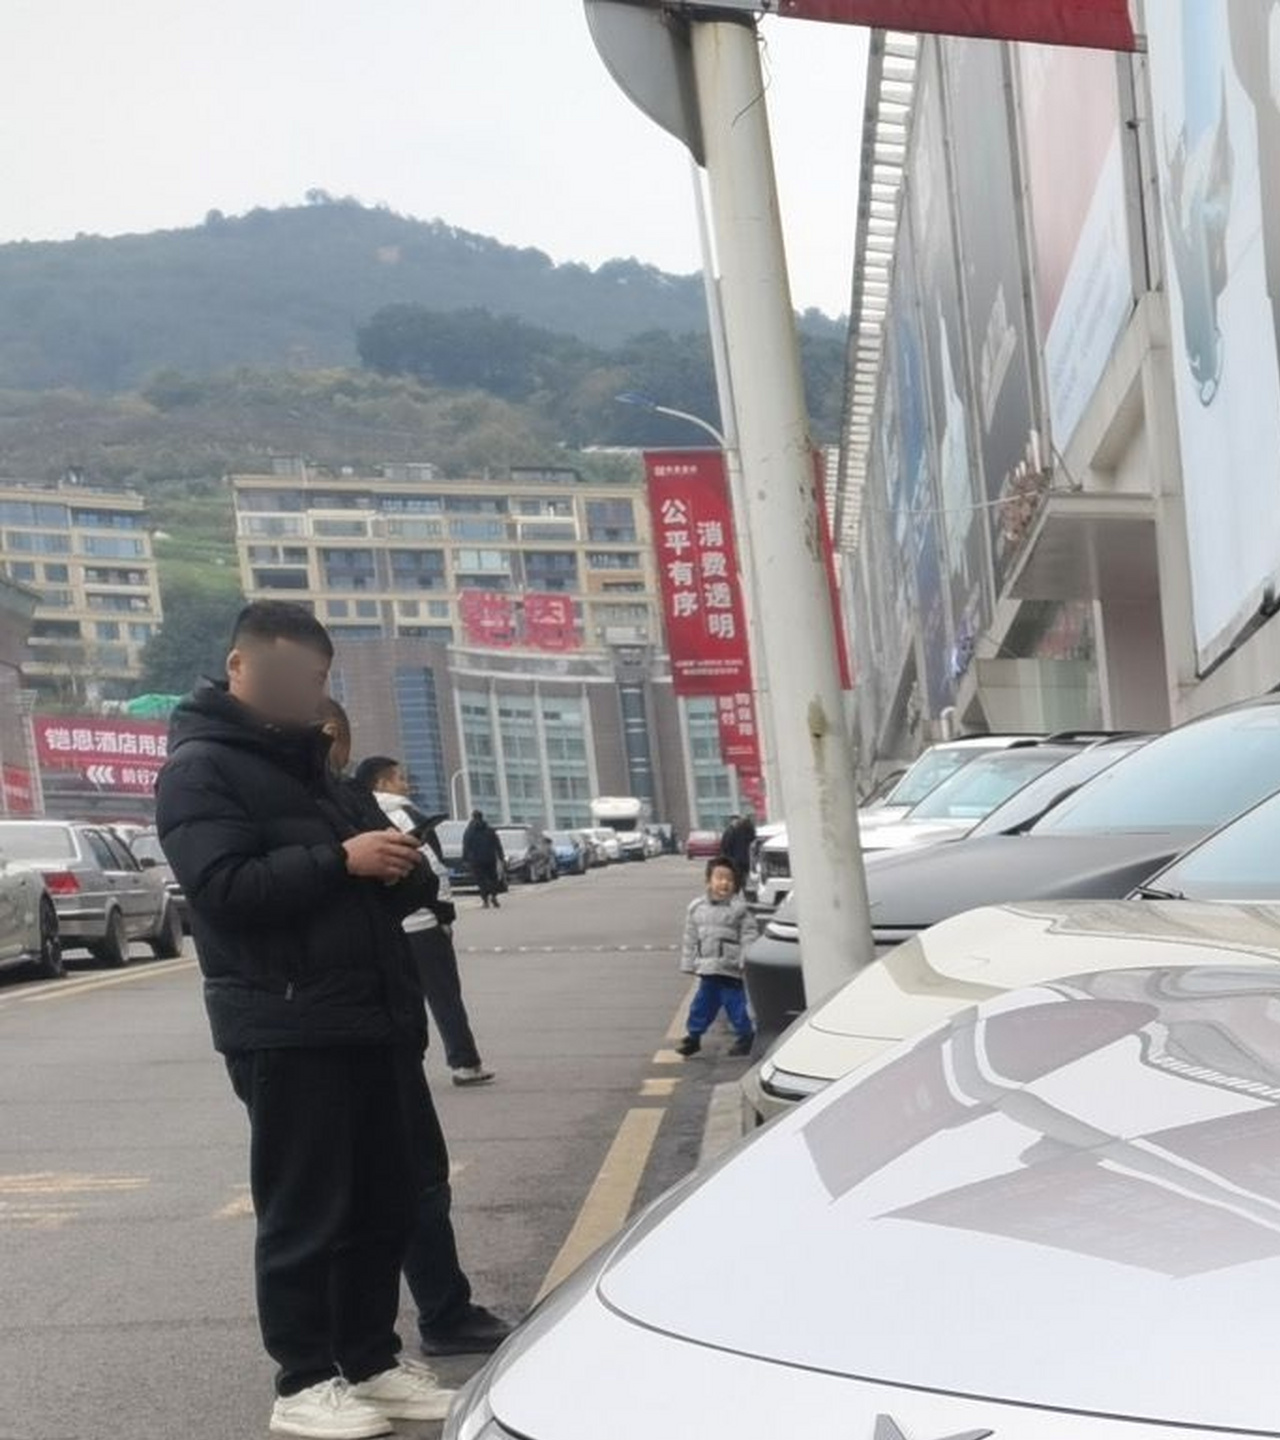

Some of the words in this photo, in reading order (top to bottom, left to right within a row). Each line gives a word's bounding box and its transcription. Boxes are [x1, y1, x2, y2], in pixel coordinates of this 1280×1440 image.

[661, 499, 699, 618] 公平有序
[696, 520, 736, 639] 消费透明
